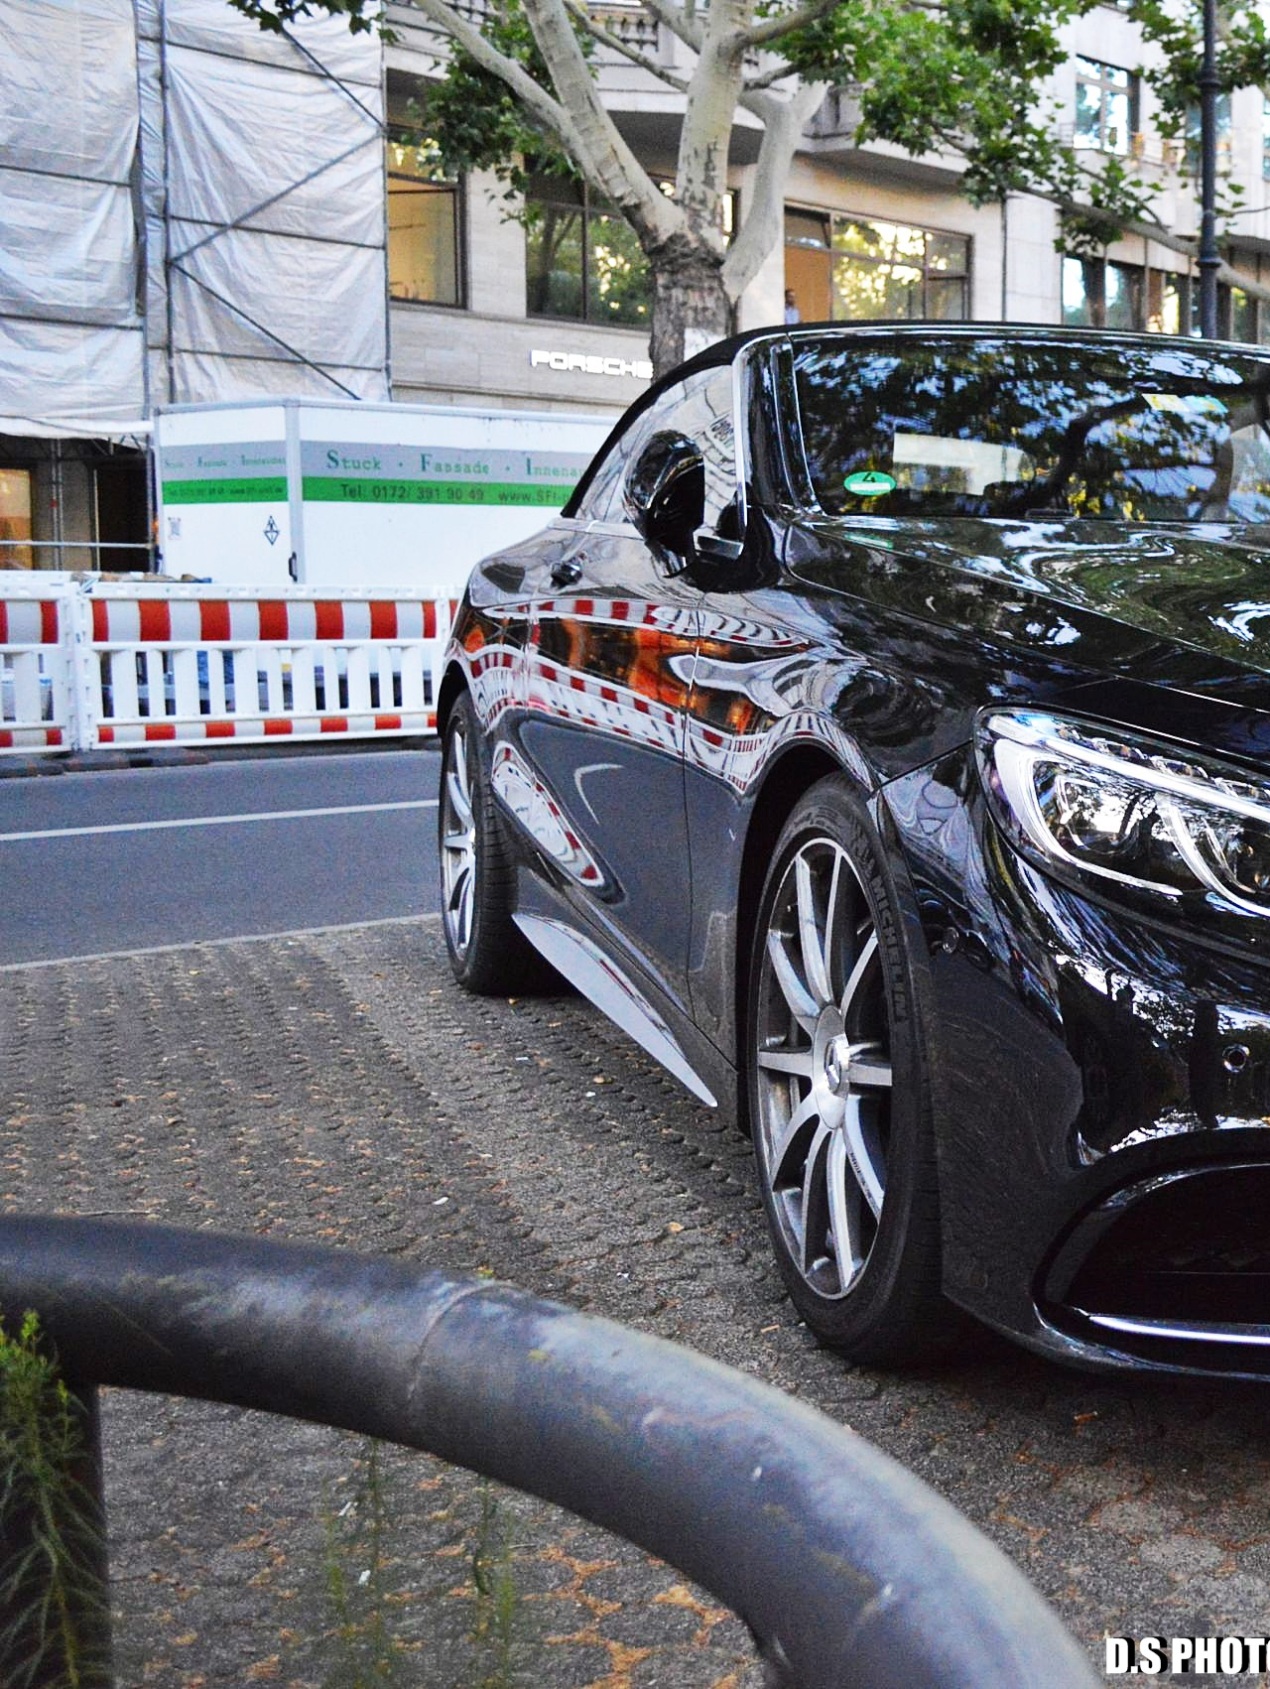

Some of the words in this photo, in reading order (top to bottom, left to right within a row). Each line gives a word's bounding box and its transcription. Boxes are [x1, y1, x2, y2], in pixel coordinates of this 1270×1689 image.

[530, 349, 654, 379] PORSCHE
[326, 449, 381, 471] Stuck
[420, 453, 489, 475] Fassade
